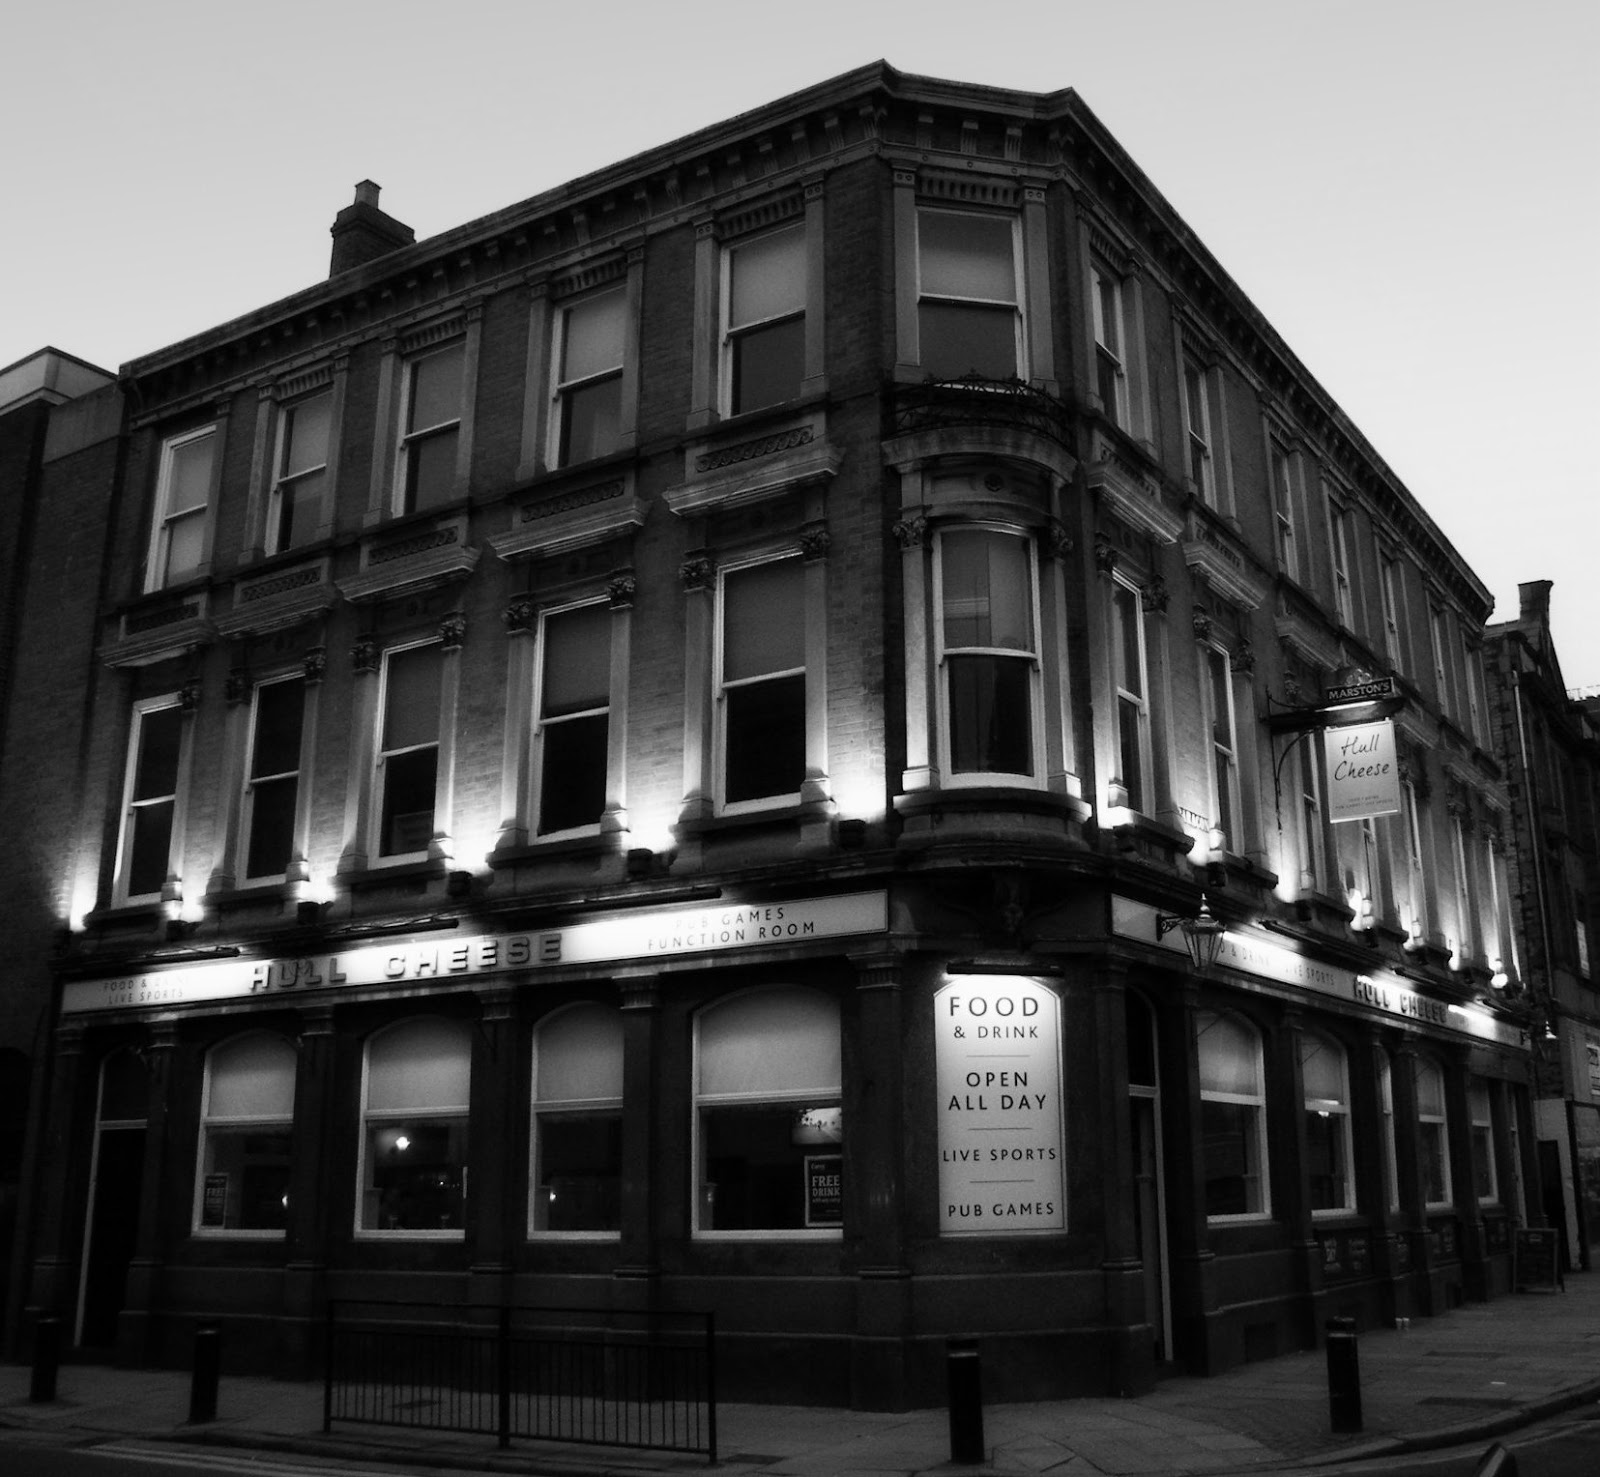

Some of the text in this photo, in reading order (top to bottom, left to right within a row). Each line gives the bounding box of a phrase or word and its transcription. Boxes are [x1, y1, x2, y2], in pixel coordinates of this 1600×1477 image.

[1328, 681, 1390, 700] MARSTON'S
[1341, 733, 1380, 757] Hull
[1334, 760, 1390, 782] Cheese
[722, 907, 785, 926] GAMES
[648, 921, 815, 951] FUNCTION ROOM
[250, 933, 562, 991] HULL CHEESE
[103, 979, 134, 992] FOOD
[141, 978, 148, 989] &
[1306, 967, 1335, 986] SPORTS
[108, 988, 184, 1004] LIVE SPORTS
[1354, 979, 1391, 1009] HULL
[949, 996, 1039, 1017] FOOD
[953, 1025, 1039, 1039] & DRINK
[966, 1072, 1028, 1088] OPEN
[948, 1094, 1047, 1111] ALL DAY
[942, 1147, 1057, 1162] LIVE SPORTS
[812, 1174, 841, 1187] FREE
[812, 1187, 841, 1197] DRINK
[948, 1202, 1055, 1218] PUB GAMES
